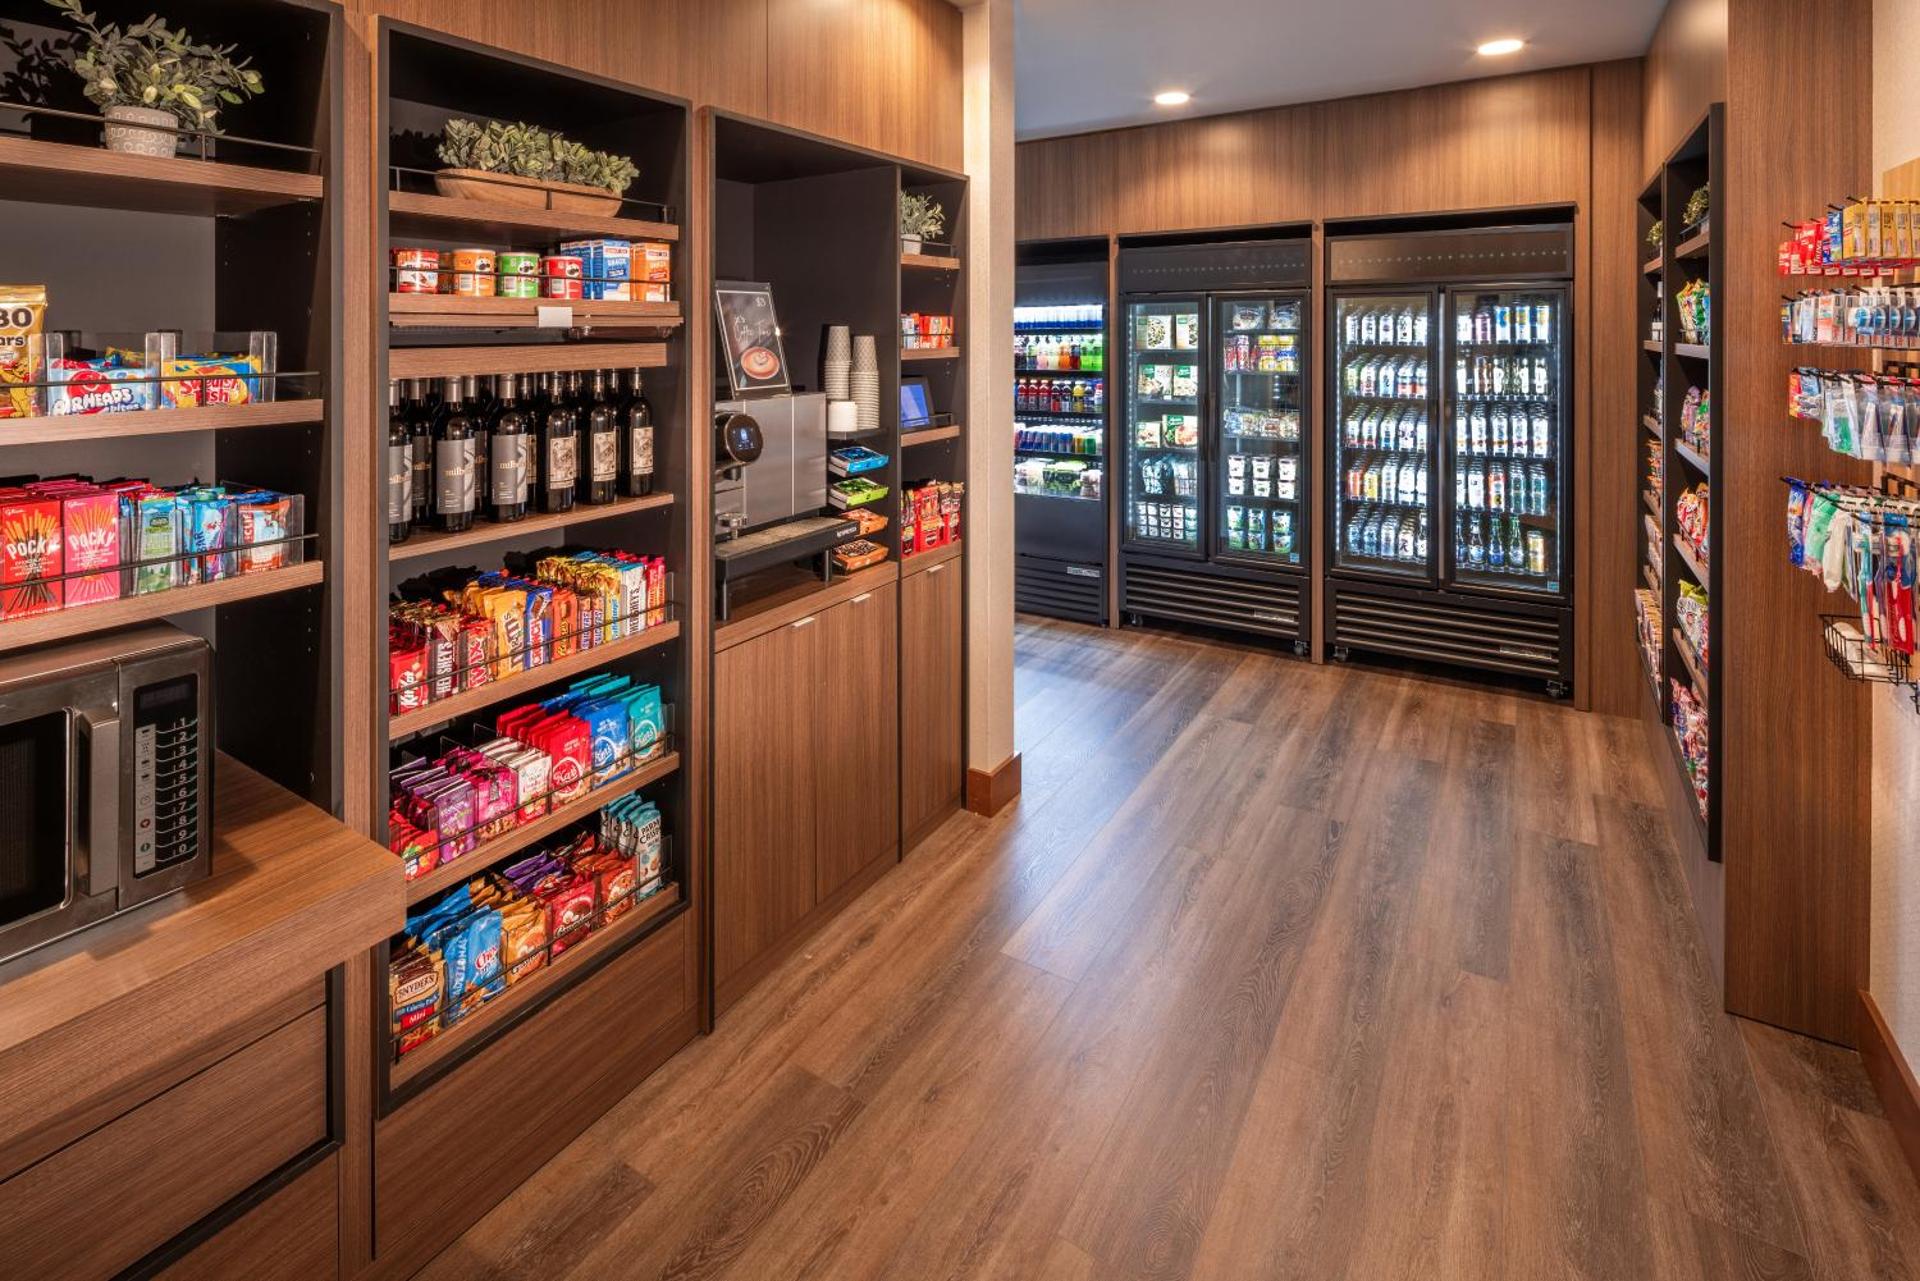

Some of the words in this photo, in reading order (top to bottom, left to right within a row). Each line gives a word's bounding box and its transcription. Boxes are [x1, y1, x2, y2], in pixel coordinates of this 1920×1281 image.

[180, 718, 187, 727] 1
[180, 731, 187, 741] 2
[180, 745, 187, 754] 3
[180, 760, 187, 769] 4
[180, 773, 187, 783] 5
[180, 787, 187, 797] 6
[180, 801, 187, 811] 7
[180, 815, 187, 825] 8
[180, 829, 187, 840] 9
[180, 844, 187, 853] 0
